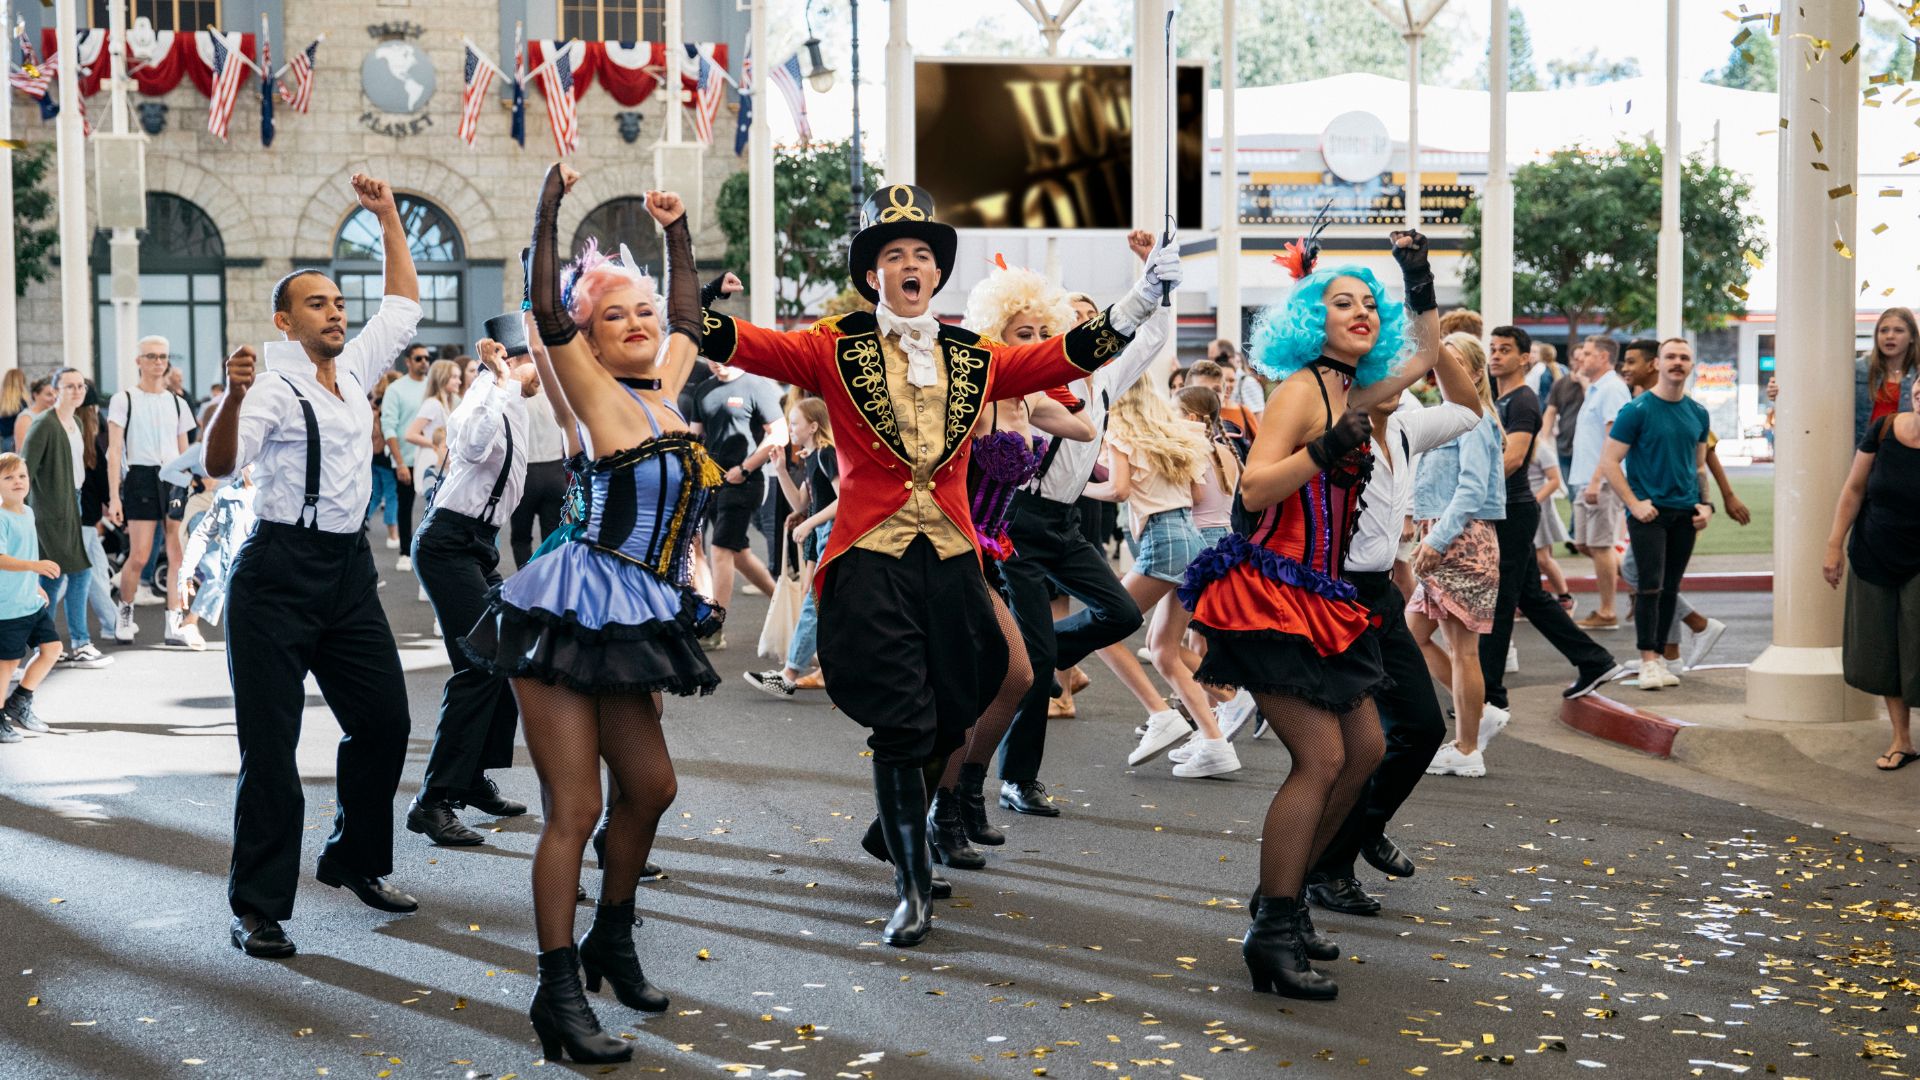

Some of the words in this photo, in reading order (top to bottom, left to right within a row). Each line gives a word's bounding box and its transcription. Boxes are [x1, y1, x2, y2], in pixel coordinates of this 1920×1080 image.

[359, 110, 433, 136] PLANET
[1250, 196, 1303, 208] CUSTOM
[1392, 196, 1402, 208] &
[1421, 197, 1466, 209] INTING
